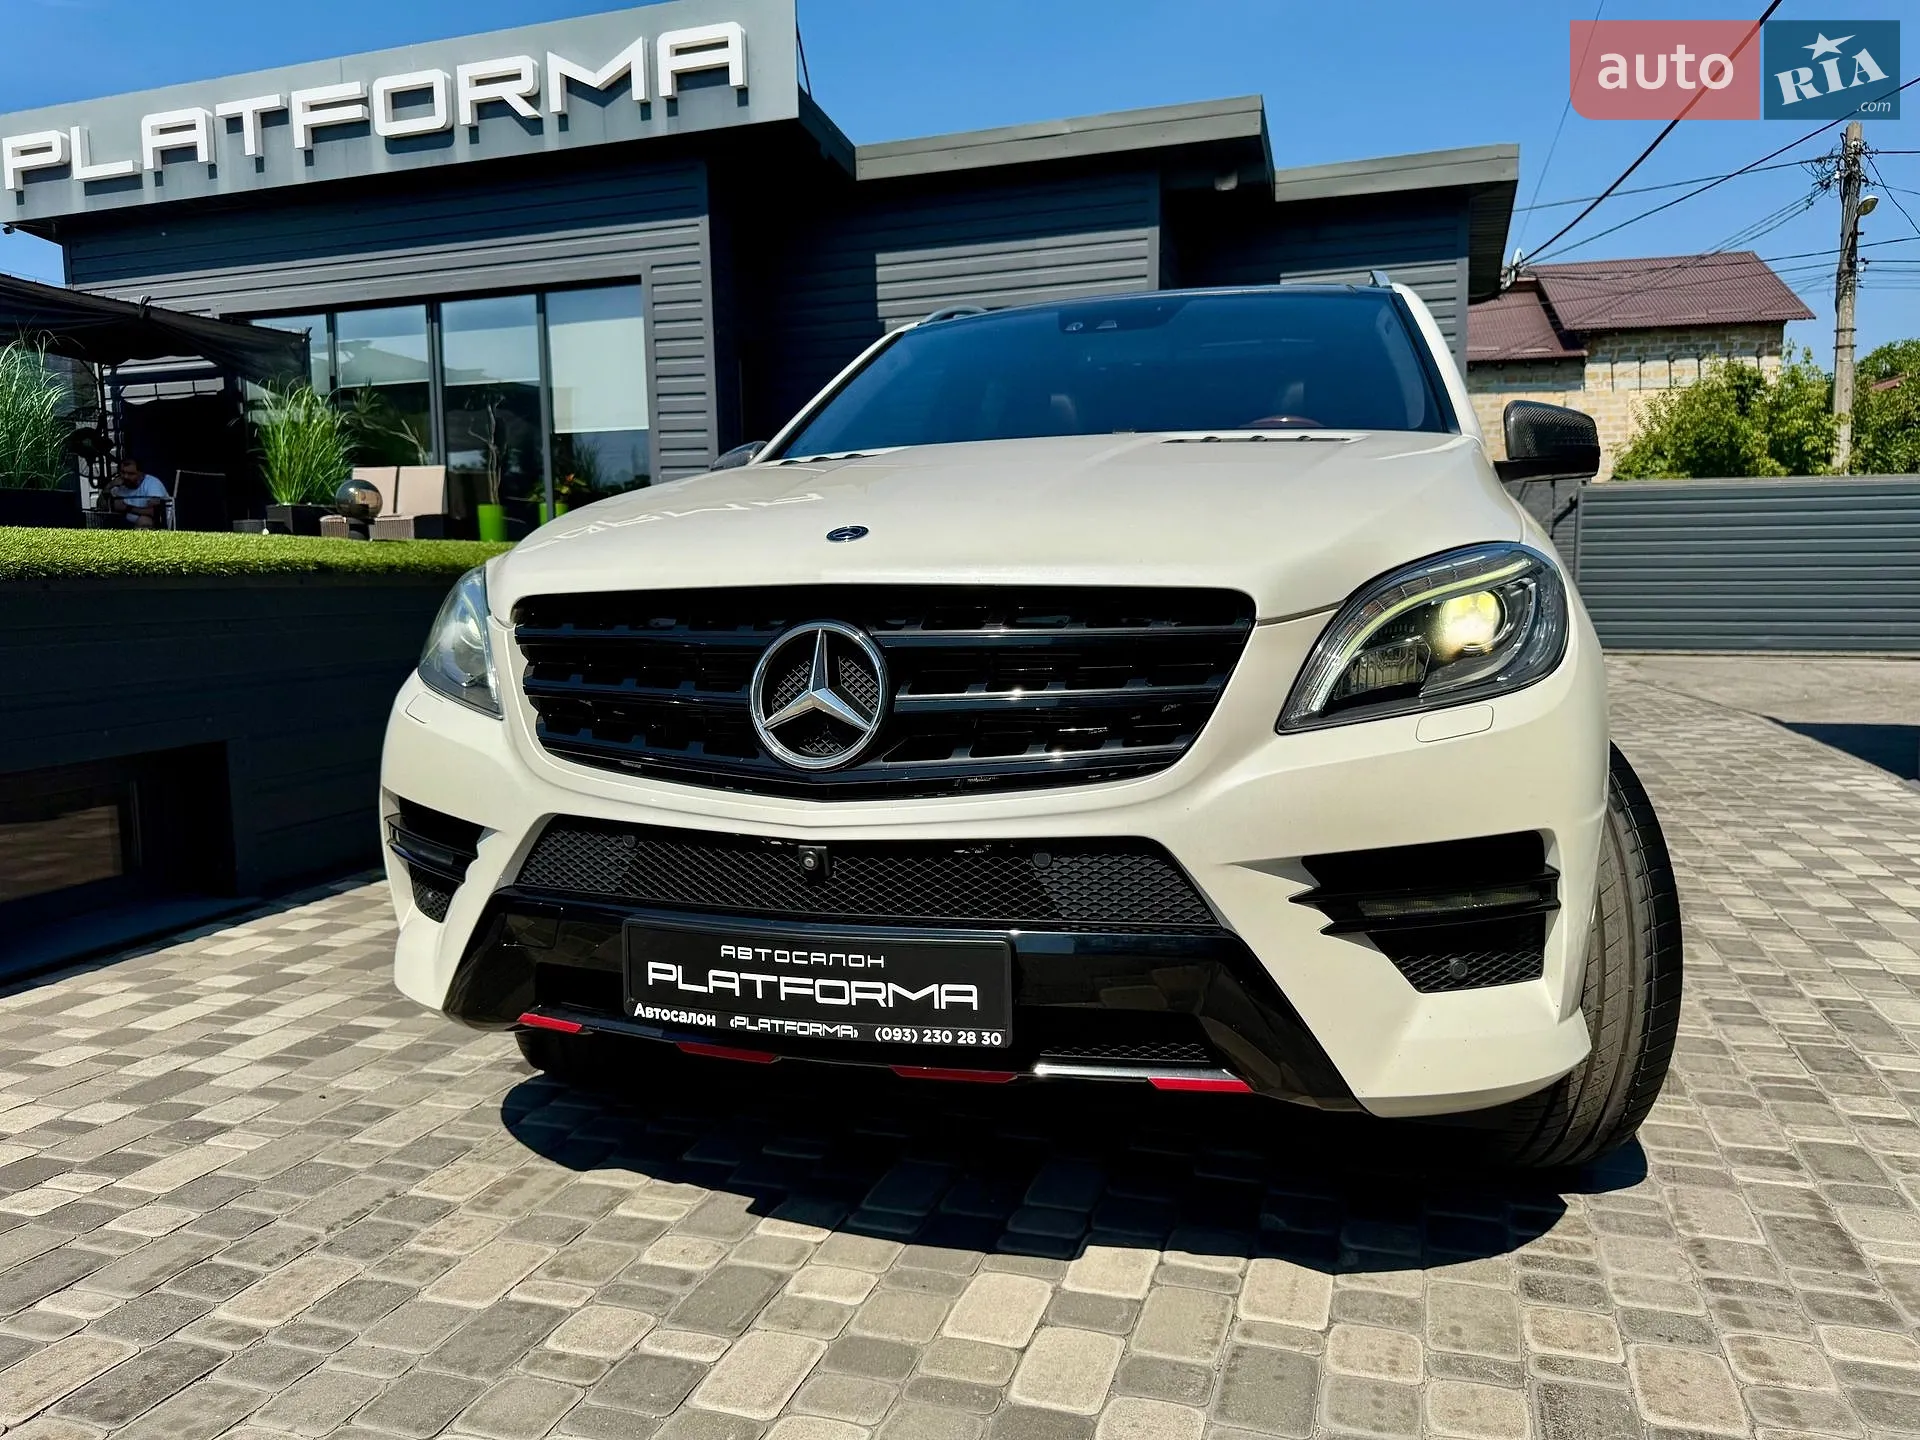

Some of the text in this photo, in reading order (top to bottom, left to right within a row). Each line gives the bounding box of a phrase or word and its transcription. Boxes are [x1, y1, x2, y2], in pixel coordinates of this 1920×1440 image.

[2, 21, 748, 192] PLATFORMA
[720, 945, 886, 968] АВТОСАЛОН
[647, 962, 978, 1011] PLATFORMA
[633, 1004, 716, 1027] Автосалон
[875, 1027, 918, 1044] (093)
[922, 1029, 952, 1044] 230
[957, 1030, 977, 1045] 28
[981, 1031, 1002, 1046] 30
